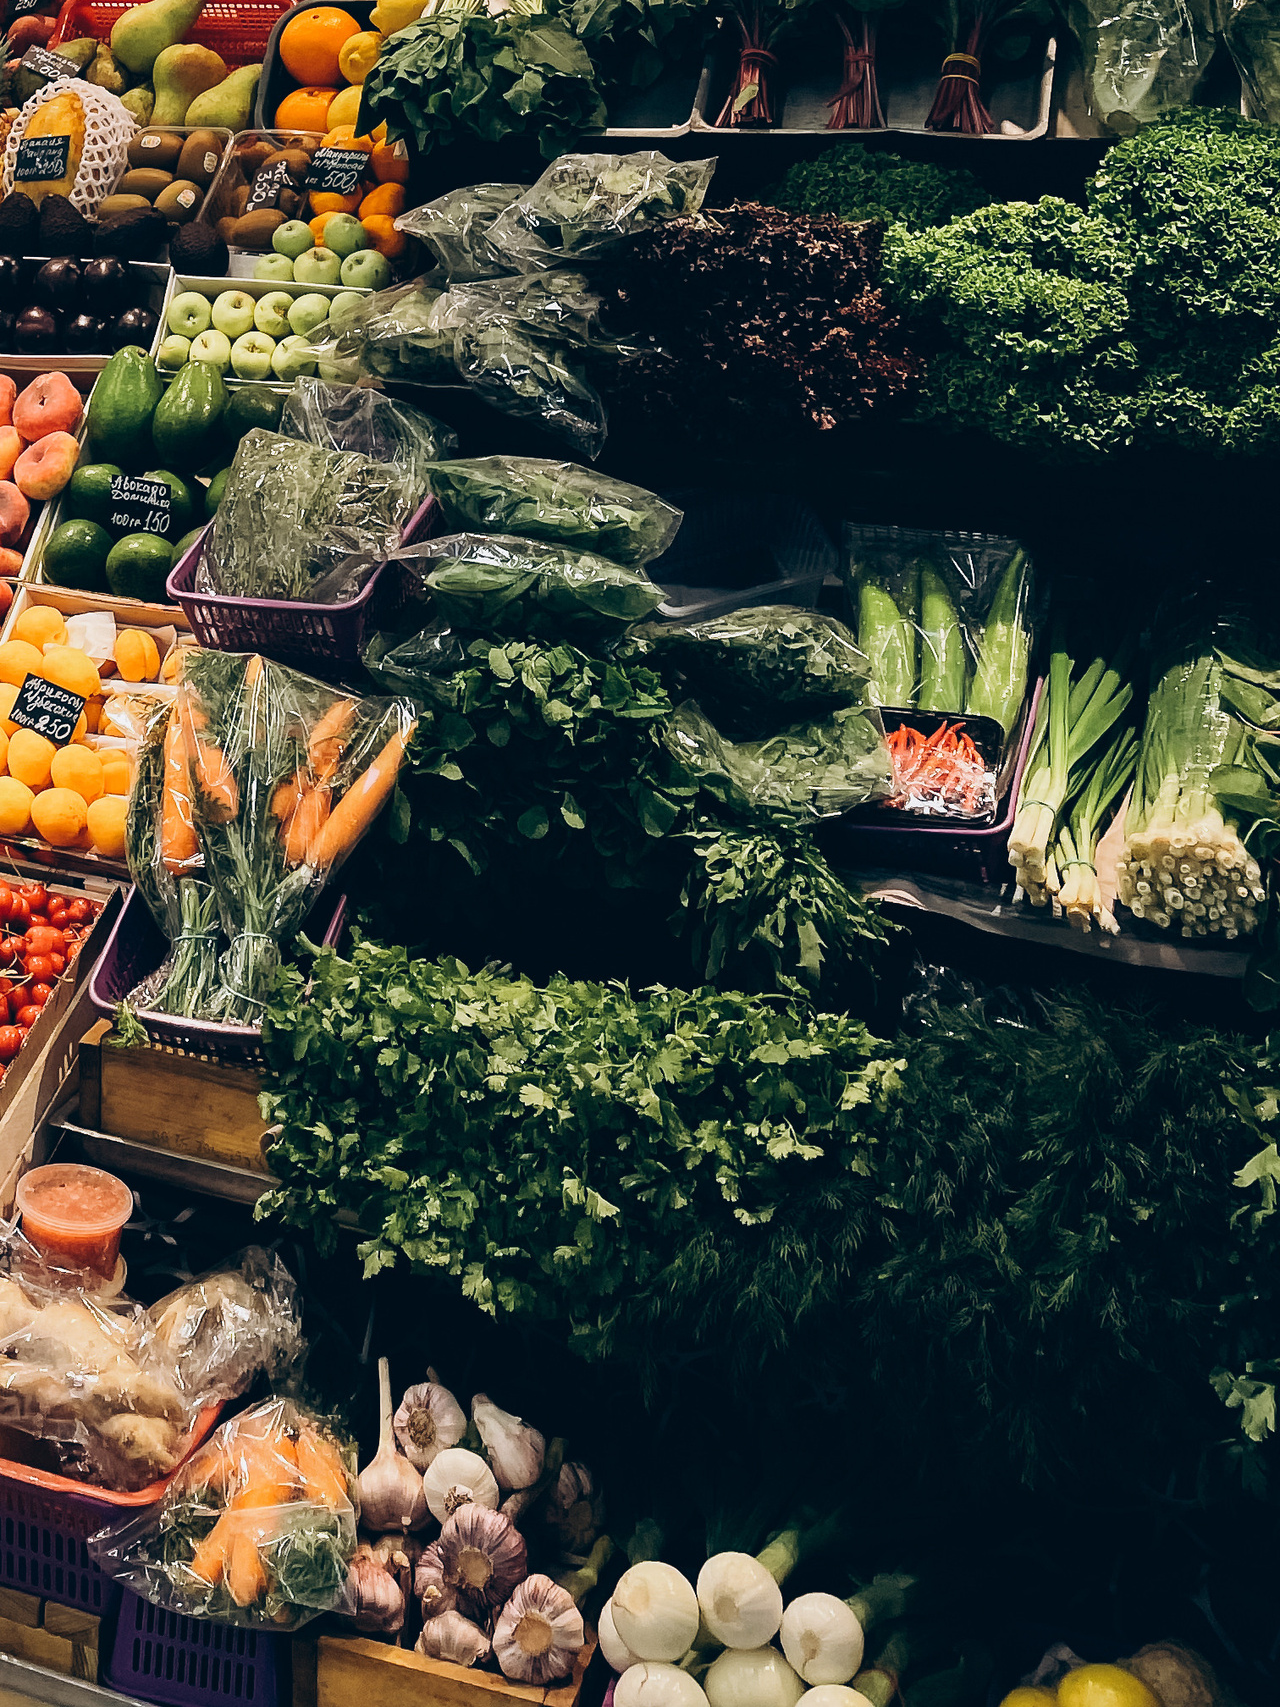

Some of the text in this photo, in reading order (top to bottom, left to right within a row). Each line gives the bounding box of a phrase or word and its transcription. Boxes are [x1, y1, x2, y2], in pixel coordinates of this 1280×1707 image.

[112, 476, 167, 497] Авокадо
[142, 510, 171, 533] 150
[34, 715, 71, 741] 250
